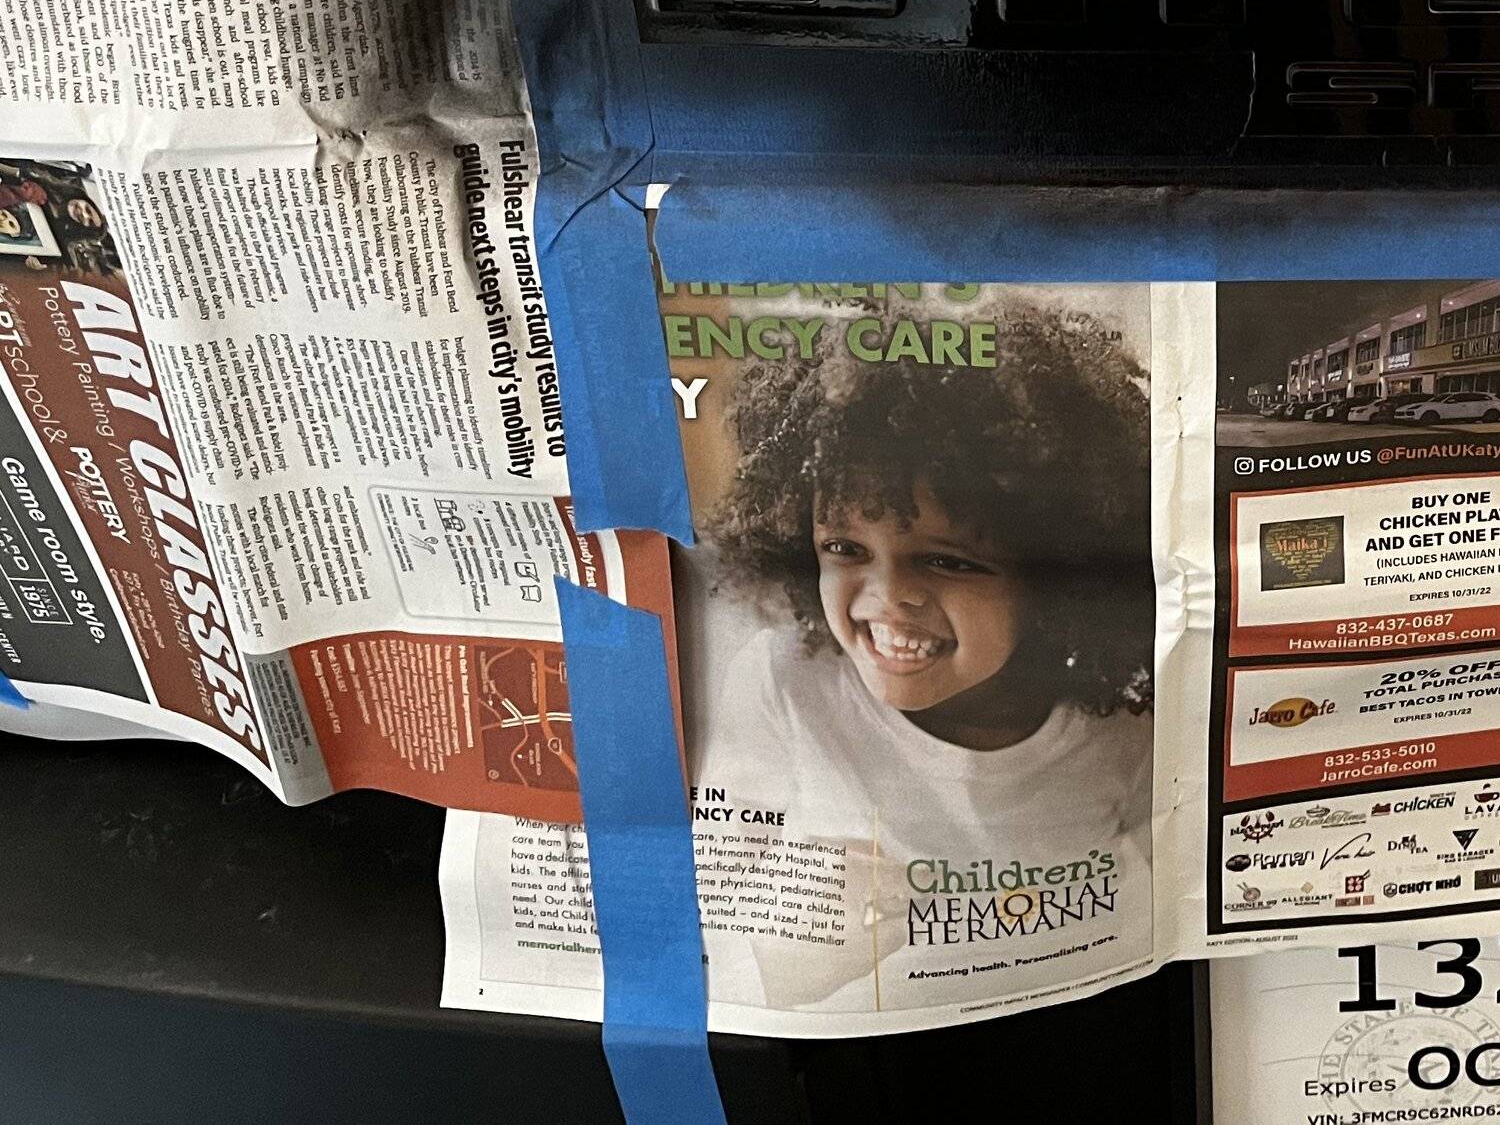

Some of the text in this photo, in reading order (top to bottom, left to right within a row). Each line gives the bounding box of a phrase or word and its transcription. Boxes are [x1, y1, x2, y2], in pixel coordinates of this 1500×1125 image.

[453, 143, 534, 482] guide next steps in city's mobility
[499, 139, 568, 459] Fulshear transit study results to
[846, 317, 998, 368] CARE
[36, 285, 160, 561] Pottery Painting Workshops
[1259, 452, 1341, 473] FOLLOW
[1346, 449, 1372, 465] US
[1, 457, 45, 523] Game
[36, 523, 81, 585] room
[62, 280, 263, 753] ART CLASSES
[1365, 534, 1405, 552] AND
[1408, 531, 1445, 547] GET
[1448, 527, 1486, 544] ONE
[1379, 511, 1463, 530] CHICKEN
[1288, 625, 1497, 650] HawaiianBBQTexas.com
[1335, 613, 1454, 635] 832-437-0687
[1320, 756, 1437, 782] JarroCafe.com
[906, 849, 1116, 896] Children's
[907, 873, 1119, 925] MEMORIAL
[907, 894, 1116, 947] HERMANN
[908, 964, 969, 981] Advancing
[972, 959, 1013, 974] health.
[1091, 933, 1118, 948] care.
[1304, 1074, 1396, 1099] Expires
[1307, 1112, 1344, 1125] VIN:
